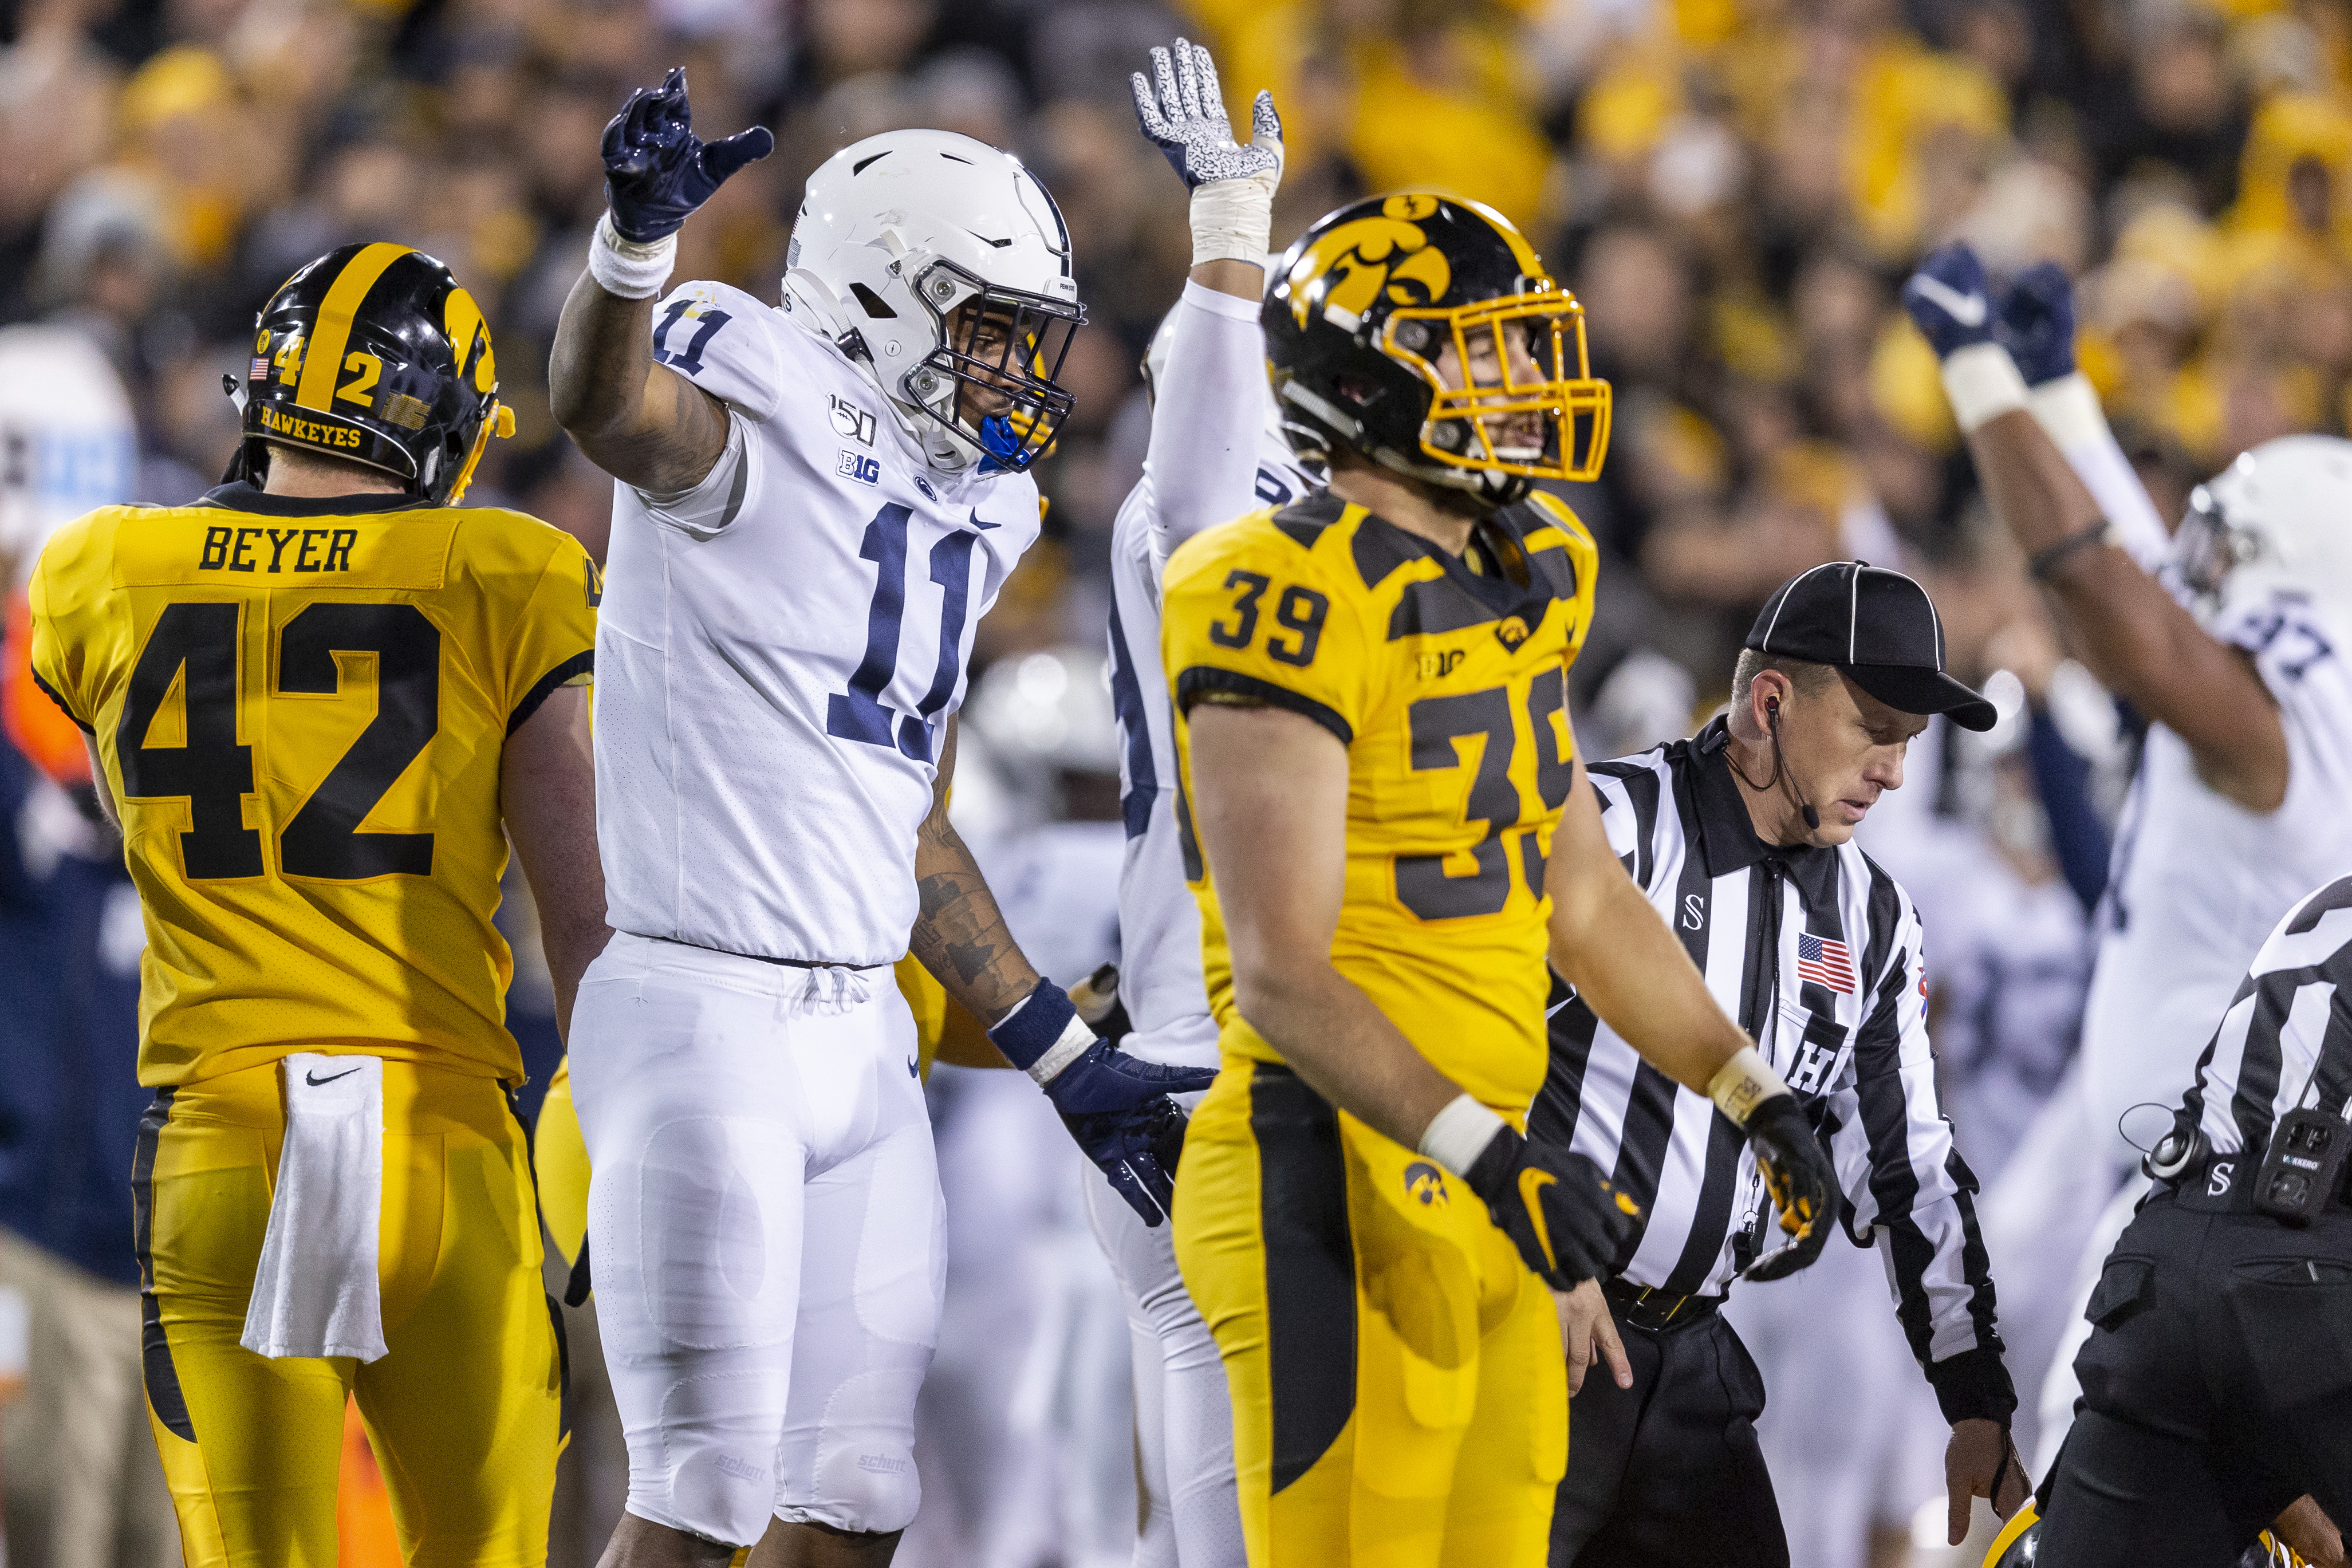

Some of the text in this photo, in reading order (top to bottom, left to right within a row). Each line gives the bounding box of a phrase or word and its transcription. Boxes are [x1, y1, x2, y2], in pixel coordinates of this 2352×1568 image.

[653, 299, 733, 377] 11
[261, 405, 361, 448] HAWKEYES
[199, 526, 358, 573] BEYER
[827, 501, 979, 766] 11
[1209, 570, 1329, 668] 39
[115, 602, 441, 880] 42
[1683, 894, 1704, 930] S
[1787, 1041, 1836, 1094] H
[2208, 1163, 2234, 1196] S
